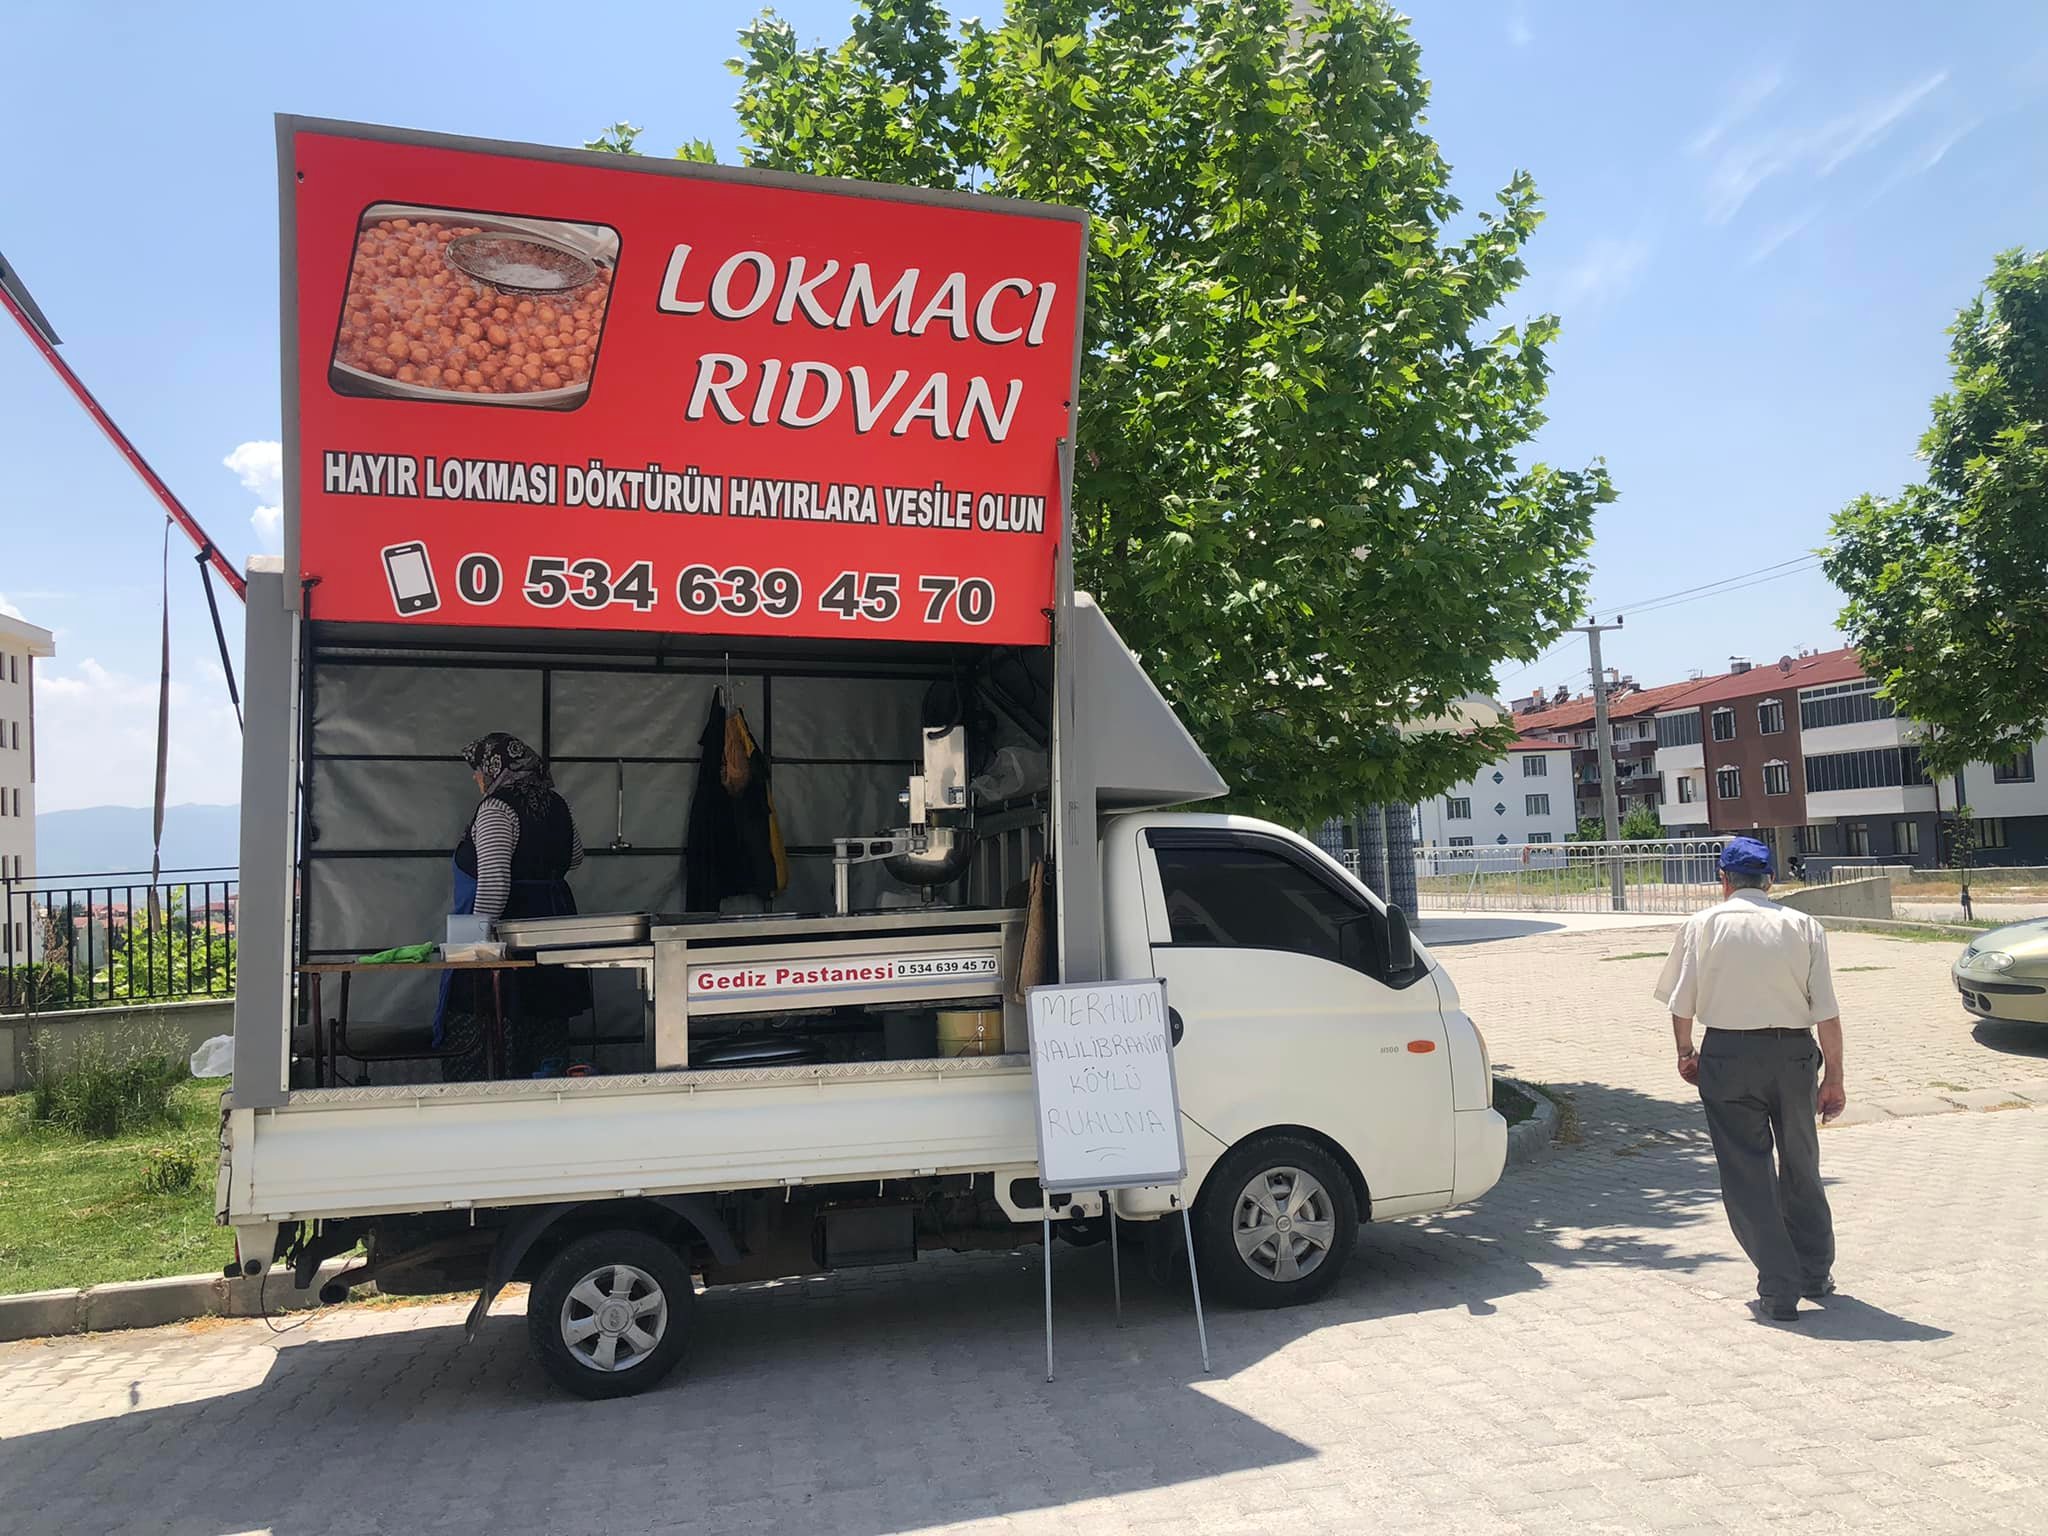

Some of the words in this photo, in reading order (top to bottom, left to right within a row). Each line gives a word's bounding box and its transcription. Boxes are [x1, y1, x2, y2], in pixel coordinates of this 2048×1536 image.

[656, 243, 1057, 346] LOKMACI
[685, 352, 1024, 443] RIDVAN
[322, 450, 418, 499] HAYIR
[425, 455, 557, 507] LOKMASI
[564, 460, 724, 518] DÖKTÜRÜN
[728, 476, 878, 525] HAYIRLARA
[884, 480, 973, 531] VESİLE
[977, 490, 1046, 534] OLUN
[455, 553, 505, 606] 0
[523, 556, 655, 613] 534
[677, 563, 802, 617] 639
[818, 571, 902, 624] 45
[917, 576, 996, 626] 70
[697, 971, 768, 991] Gediz
[776, 963, 893, 985] Pastanesi
[898, 965, 906, 975] 0
[910, 963, 933, 974] 534
[936, 961, 959, 972] 639
[962, 960, 977, 971] 45
[980, 959, 996, 970] 70
[1069, 1065, 1142, 1094] KÖYLÜ
